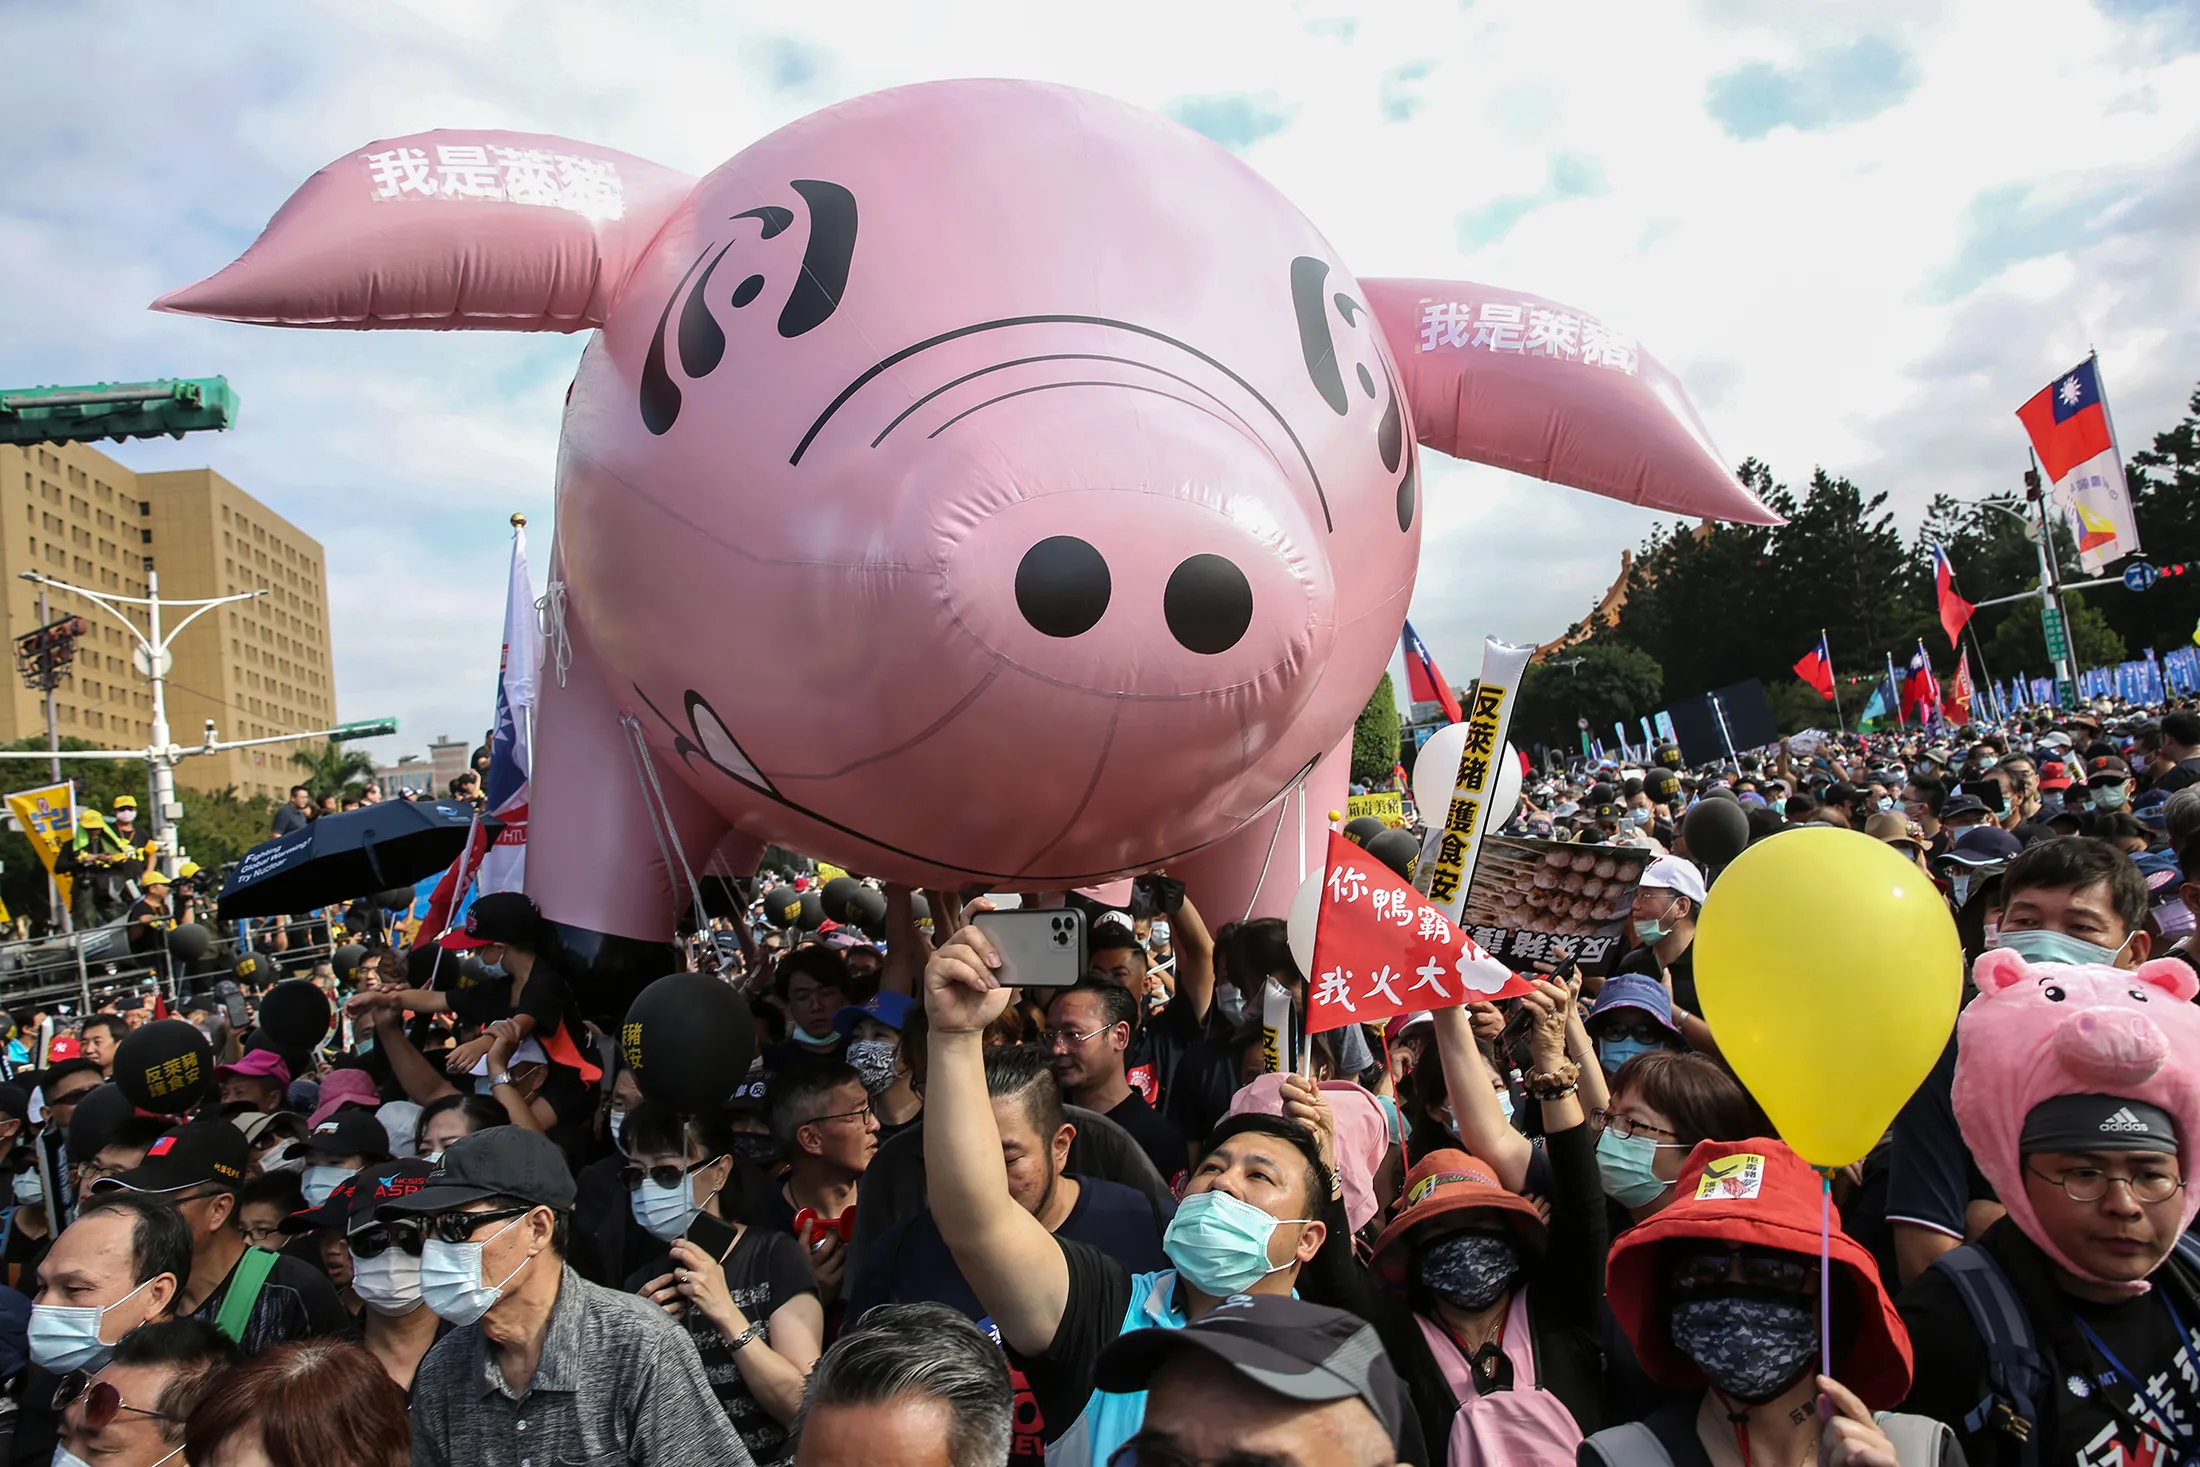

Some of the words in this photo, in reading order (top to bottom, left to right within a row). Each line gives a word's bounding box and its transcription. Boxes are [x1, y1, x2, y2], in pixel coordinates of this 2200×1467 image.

[1456, 685, 1505, 794] 反萊豬
[237, 873, 253, 884] Try
[253, 858, 287, 878] Nuclear
[240, 857, 270, 874] Global
[270, 836, 313, 861] Warming?
[244, 845, 283, 864] Fighting
[1428, 798, 1480, 904] 護食安
[1328, 865, 1451, 945] 你鴨霸
[1312, 954, 1451, 1013] 我火大
[2099, 1121, 2149, 1132] adidas
